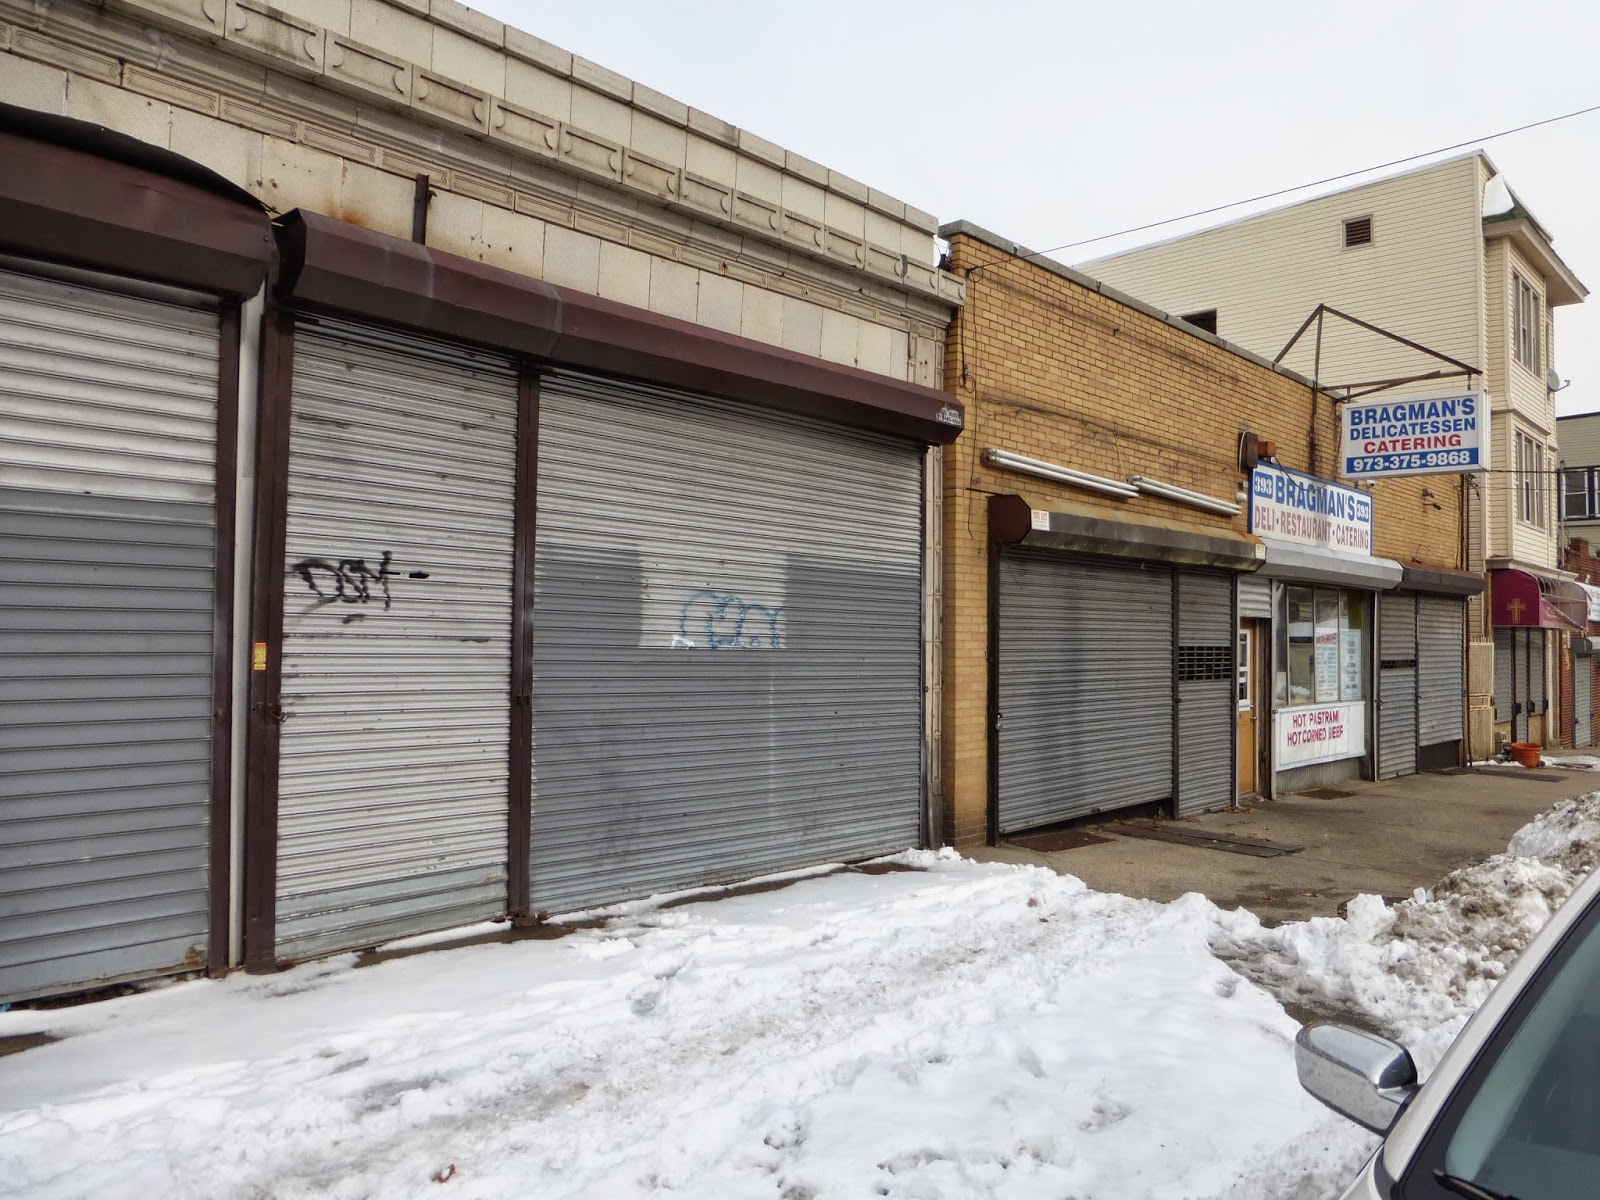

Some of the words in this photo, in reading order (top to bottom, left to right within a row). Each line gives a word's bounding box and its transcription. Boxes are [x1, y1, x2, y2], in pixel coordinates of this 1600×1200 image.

[1350, 398, 1475, 426] BRAGMAN'S
[1350, 417, 1476, 440] DELICATESSEN
[1363, 434, 1462, 454] CATERING
[1353, 451, 1470, 471] 973-375-9868
[1254, 475, 1273, 495] 393
[1275, 475, 1355, 521] BRAGMAN'S
[1356, 502, 1369, 520] 393
[1254, 505, 1275, 531] DELI
[1280, 511, 1332, 543] RESTAURANT
[1336, 524, 1369, 550] CATERING
[1292, 714, 1306, 728] HOT
[1309, 710, 1339, 726] PASTRAMI
[1287, 731, 1302, 747] HOT
[1302, 727, 1327, 743] CORNED
